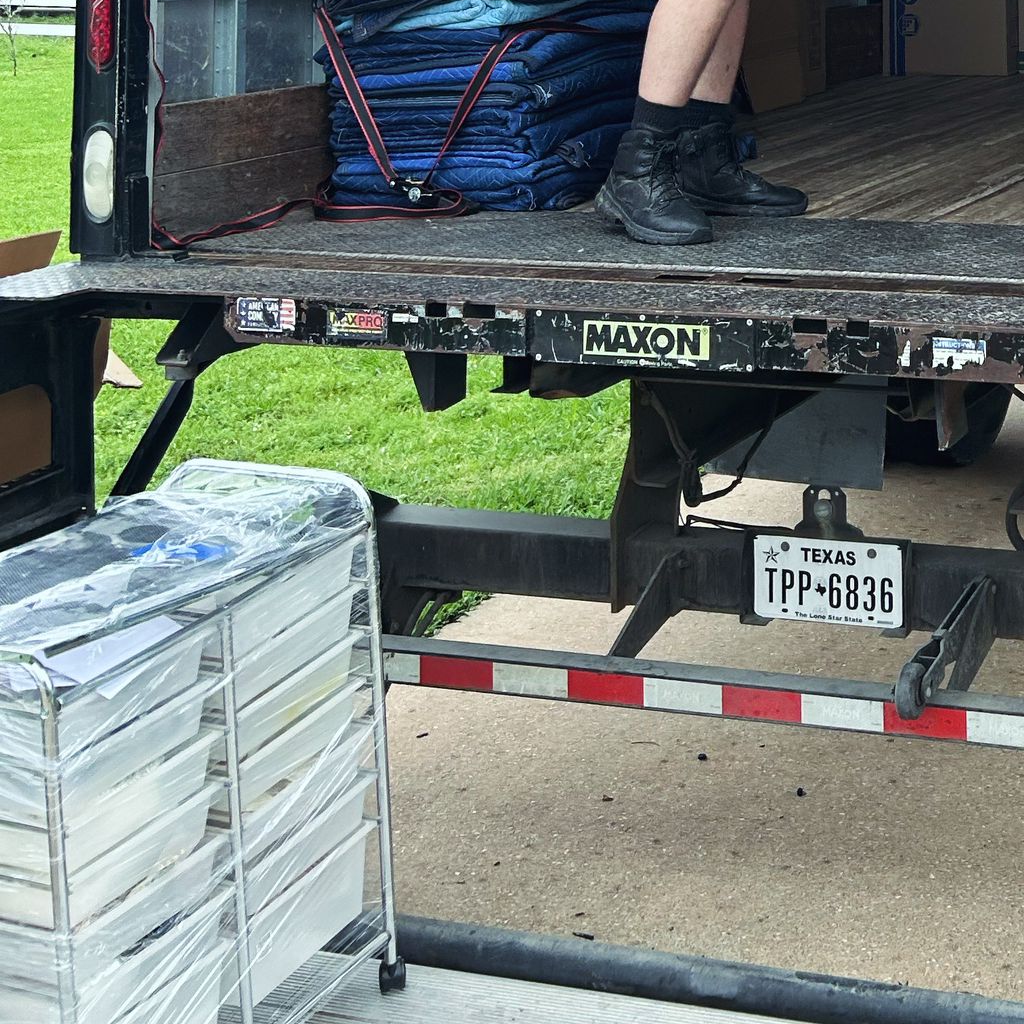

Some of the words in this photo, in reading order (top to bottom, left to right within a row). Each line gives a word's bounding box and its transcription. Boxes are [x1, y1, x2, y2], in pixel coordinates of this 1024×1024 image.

[585, 323, 701, 356] MAXON
[800, 547, 857, 566] TEXAS
[764, 567, 812, 606] TPP
[828, 573, 894, 613] 6836
[844, 615, 863, 623] State
[822, 705, 861, 721] MAXON
